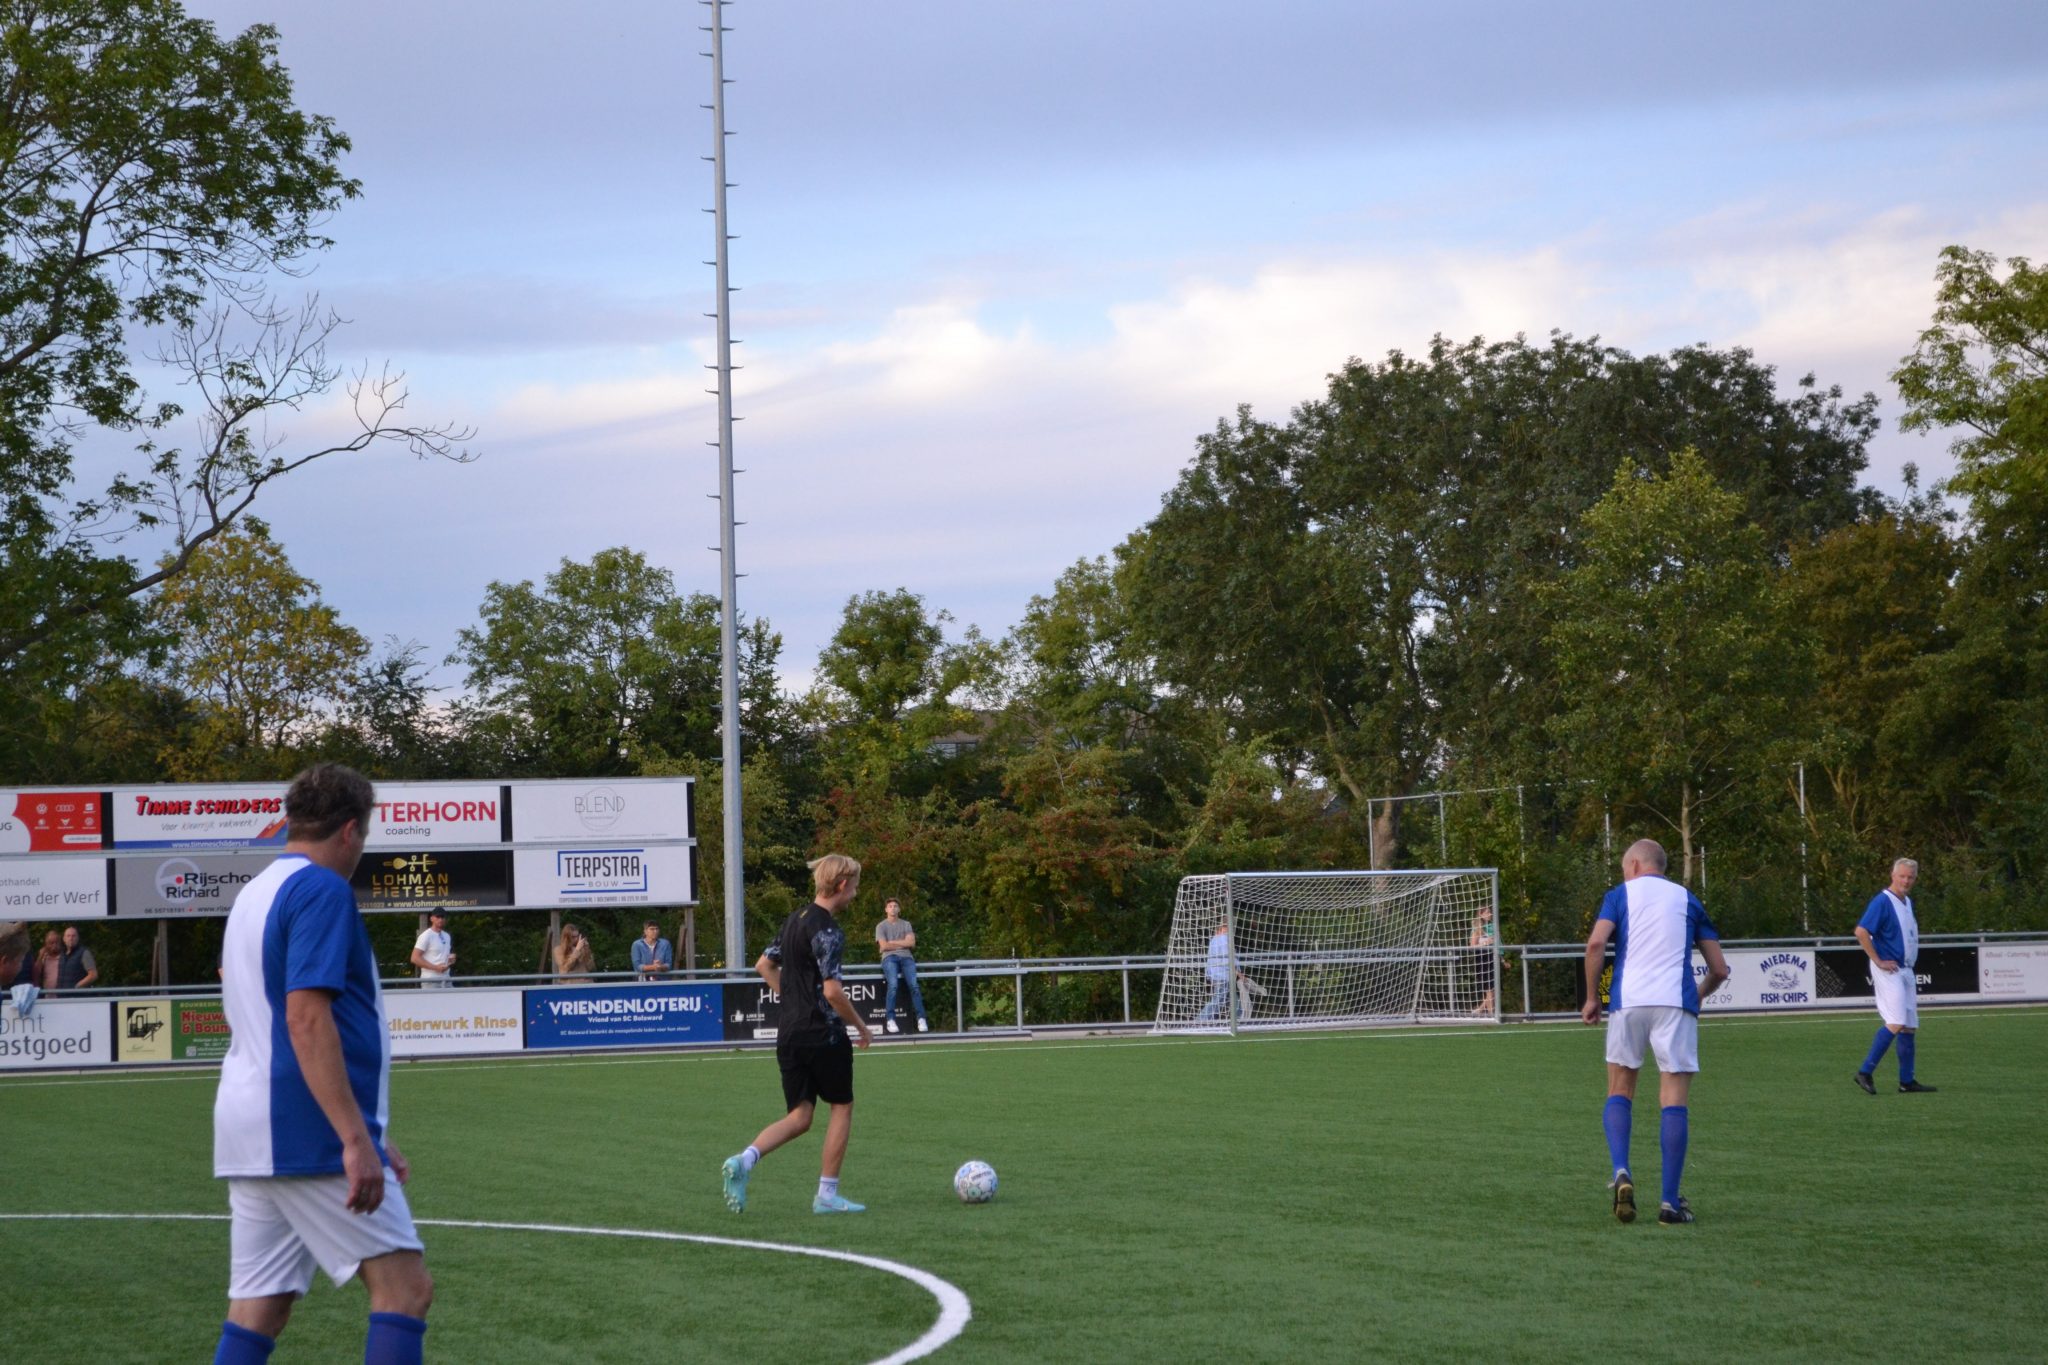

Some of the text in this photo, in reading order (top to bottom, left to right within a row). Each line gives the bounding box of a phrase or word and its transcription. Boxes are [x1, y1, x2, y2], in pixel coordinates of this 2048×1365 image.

[136, 795, 283, 816] TIMME SCHILDERS
[375, 801, 496, 823] TERHORN
[574, 796, 626, 813] BLEND
[385, 825, 431, 837] coaching
[564, 856, 640, 878] TERPSTRA
[372, 873, 449, 886] LOHMAN
[588, 880, 619, 888] BOUW
[6, 890, 101, 906] van der Werf
[166, 886, 220, 899] Richard
[372, 886, 449, 898] FIETSEN
[1760, 953, 1807, 974] MIEDEMA
[1760, 991, 1808, 1005] FISH CHIPS
[549, 996, 702, 1017] VRIENDENLOTERIJ
[474, 1015, 519, 1031] Rinse
[588, 1016, 609, 1024] Vriend
